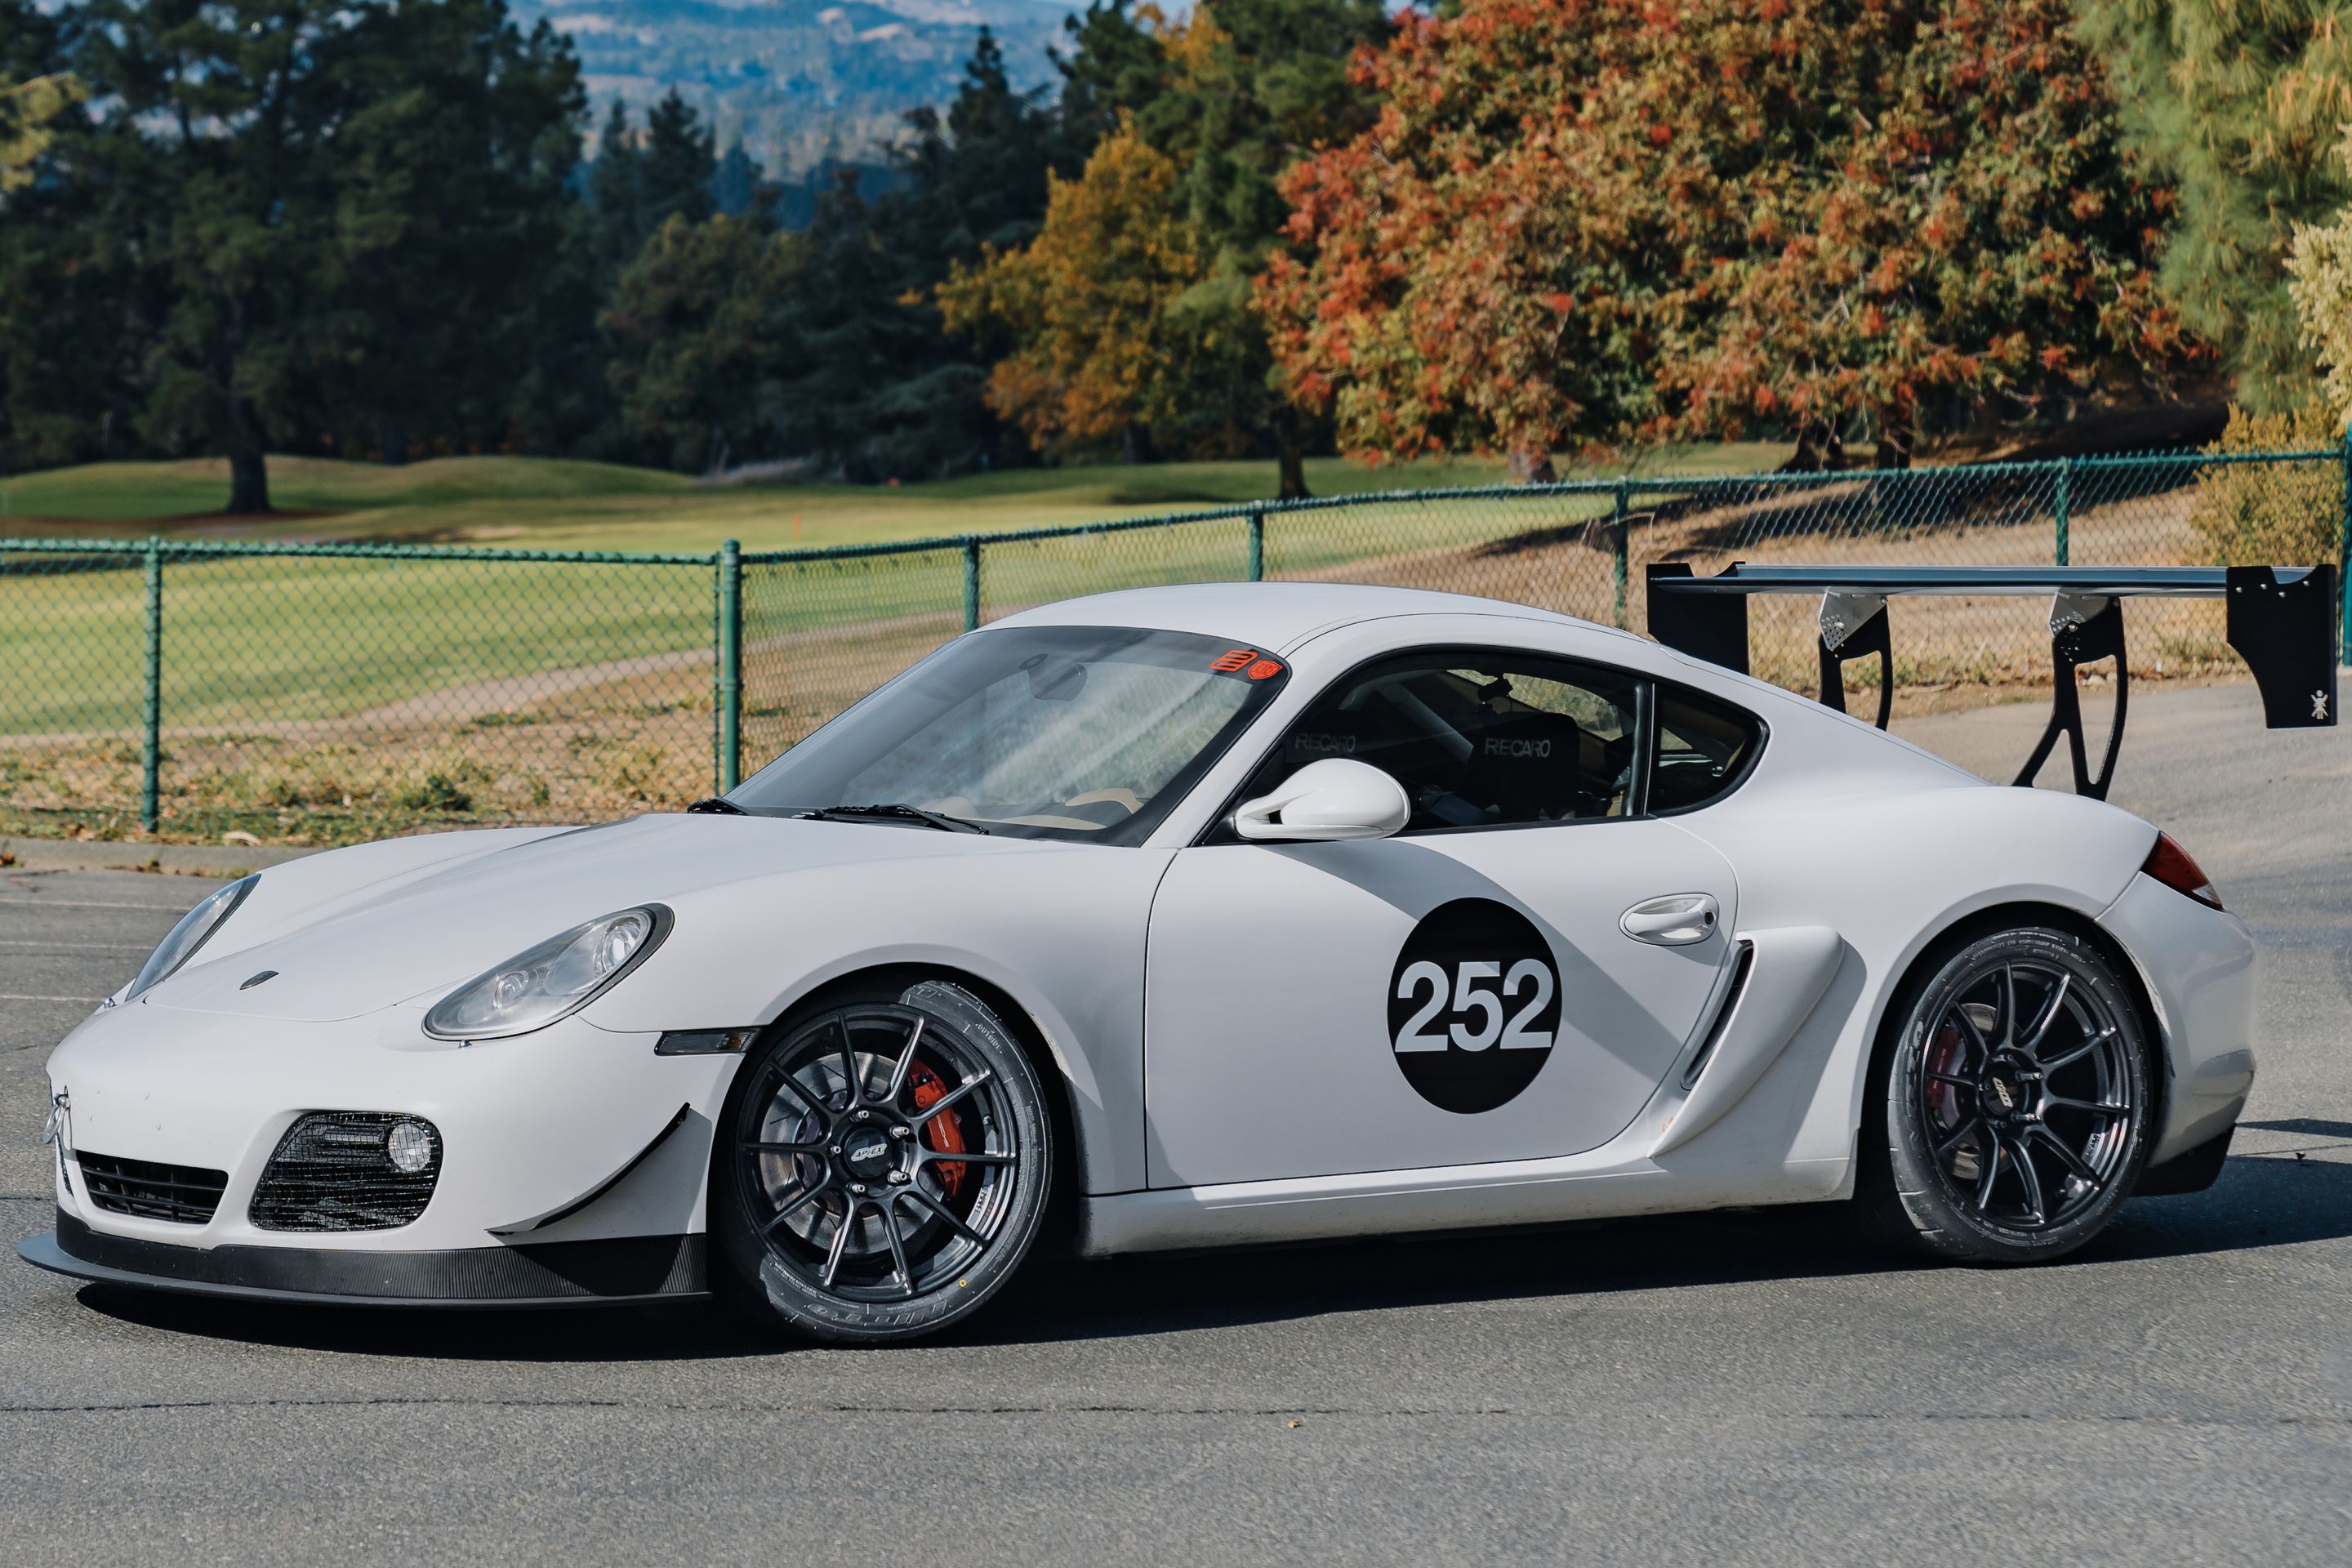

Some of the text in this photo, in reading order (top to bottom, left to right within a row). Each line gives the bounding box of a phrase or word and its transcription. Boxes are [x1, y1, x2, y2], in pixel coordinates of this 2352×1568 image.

[1294, 733, 1356, 752] RECARO
[1485, 737, 1550, 758] RECARO
[1395, 959, 1553, 1052] 252
[851, 1143, 887, 1161] APEX
